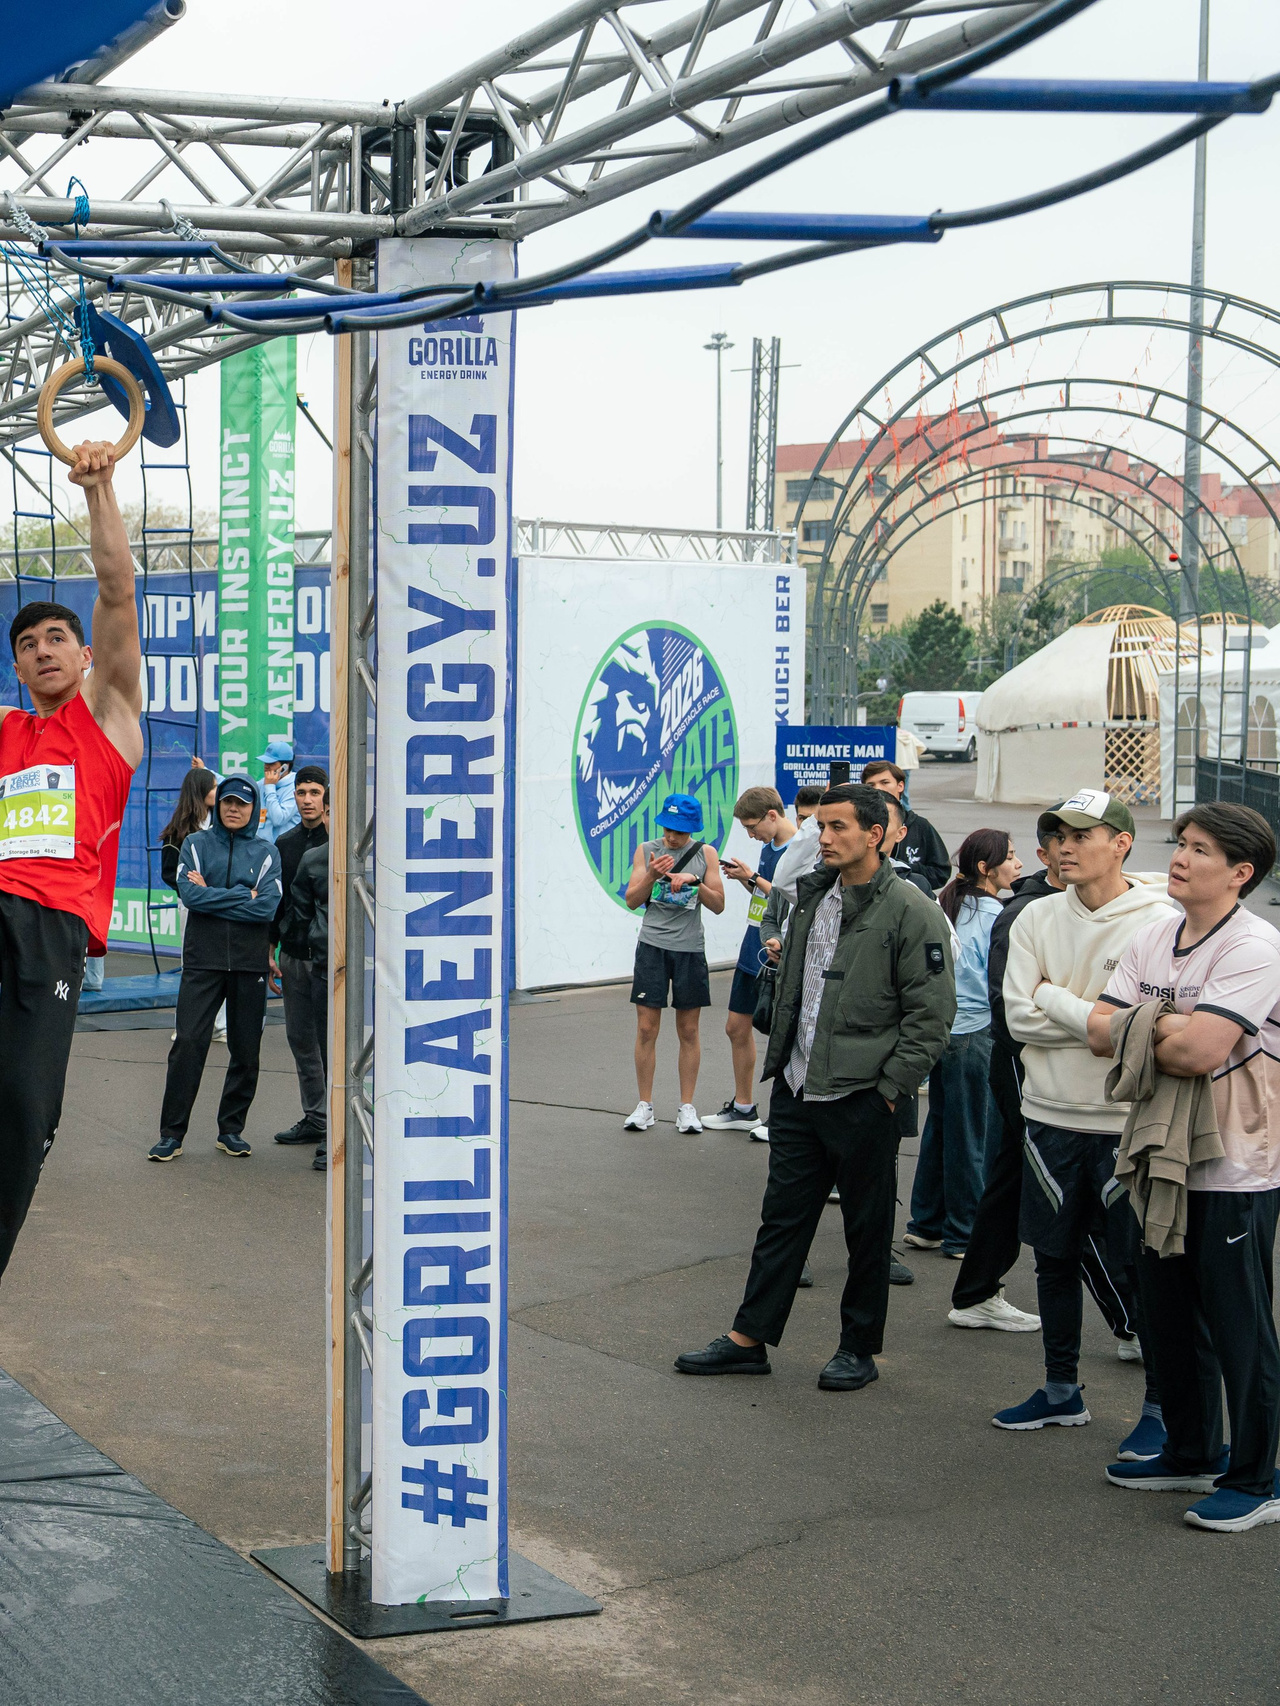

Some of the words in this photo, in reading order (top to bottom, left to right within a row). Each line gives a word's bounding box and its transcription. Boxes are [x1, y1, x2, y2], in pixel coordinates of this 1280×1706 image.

[408, 337, 499, 367] GORILLA
[420, 370, 458, 381] ENERGY
[459, 370, 488, 381] DRINK
[221, 428, 251, 613] INSTINCT
[267, 469, 294, 747] LAENERGY.UZ
[775, 575, 791, 632] BER
[221, 628, 249, 735] YOUR
[660, 647, 703, 750] 2026
[775, 646, 790, 727] KUCH
[589, 812, 620, 838] GORILLA
[618, 780, 649, 817] ULTIMATE
[661, 741, 675, 759] THE
[673, 704, 703, 742] OBSTACLE
[701, 685, 720, 706] RACE
[783, 762, 815, 771] GORILLA
[786, 744, 851, 758] ULTIMATE
[853, 744, 885, 758] MAN
[3, 804, 69, 830] 4842
[401, 413, 497, 1528] #GORILLAENERGY.UZ
